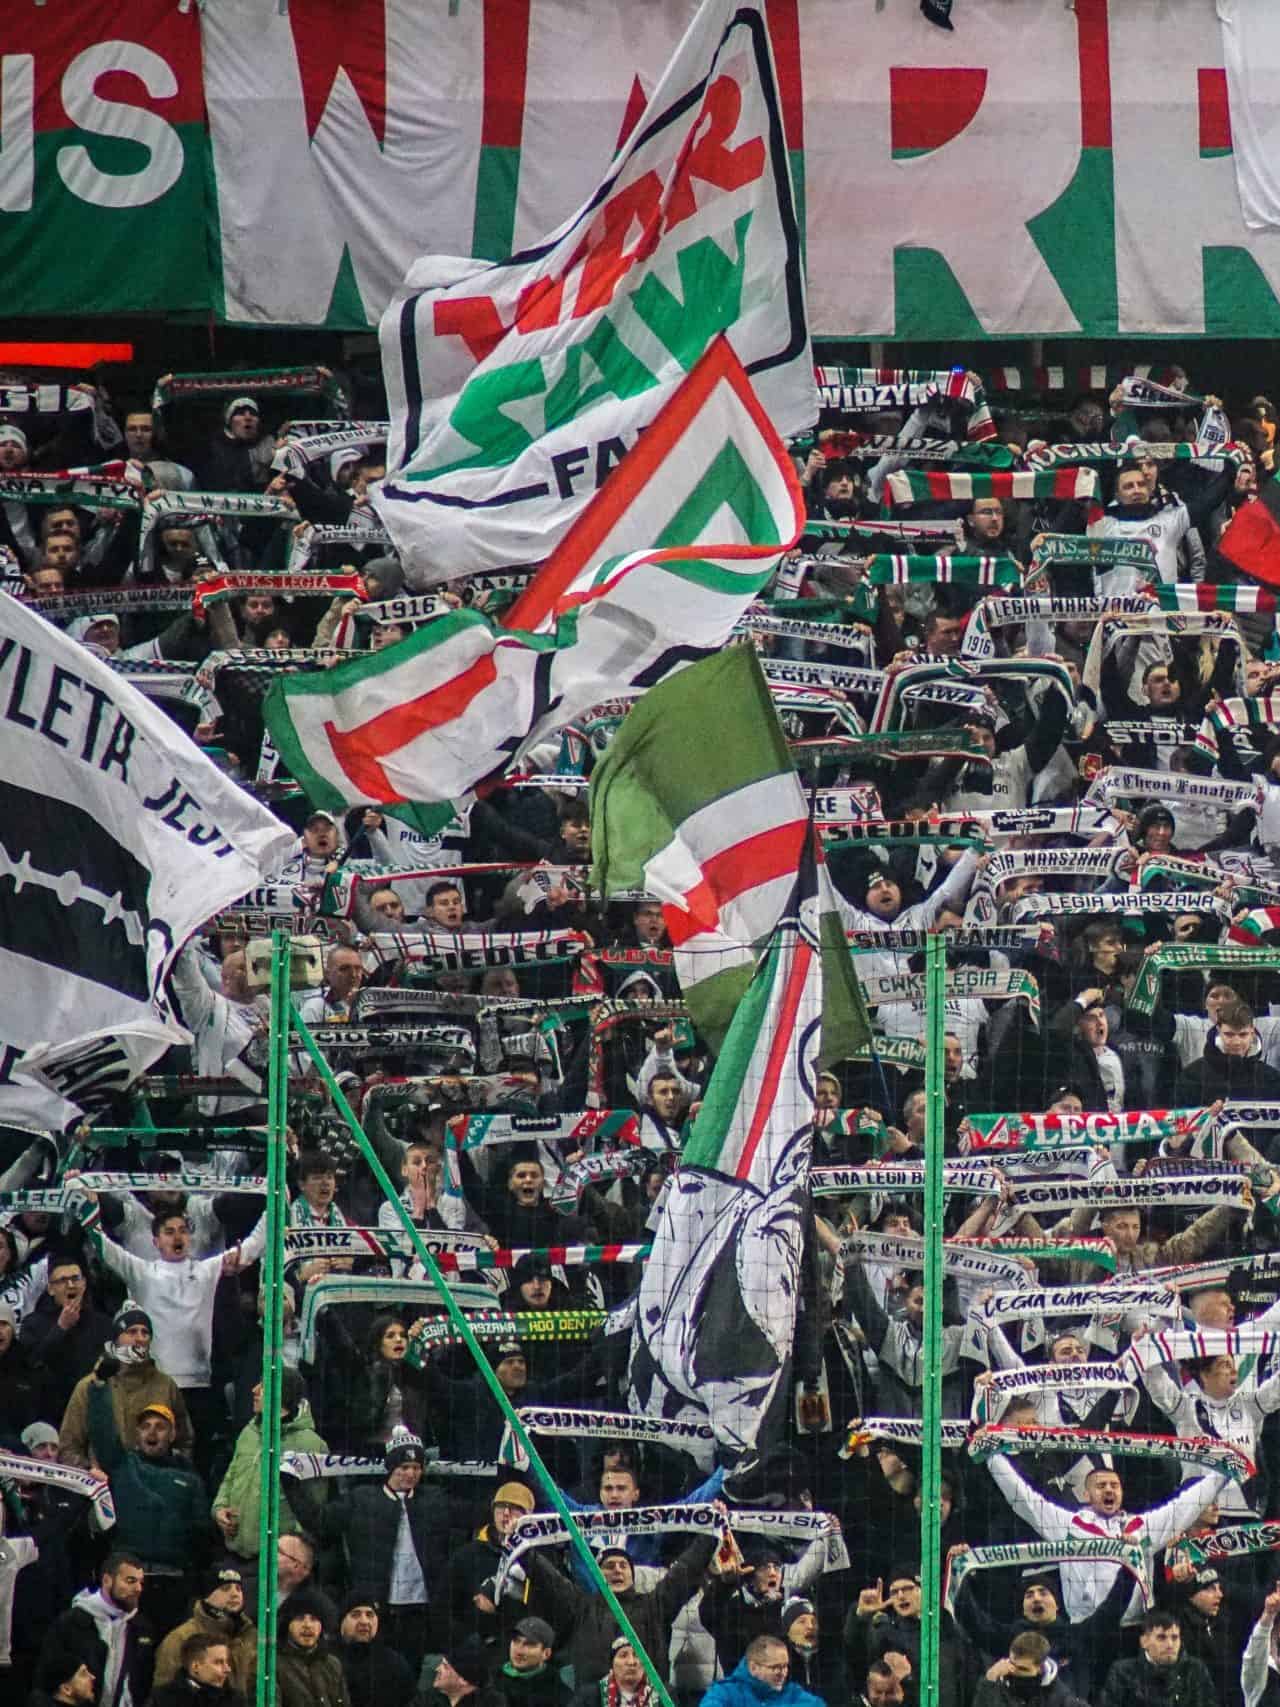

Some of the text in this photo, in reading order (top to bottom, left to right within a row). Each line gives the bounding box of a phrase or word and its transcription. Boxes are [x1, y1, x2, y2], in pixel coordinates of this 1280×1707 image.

[222, 576, 330, 589] CWKS LEGIA
[377, 597, 436, 621] 1916
[993, 596, 1041, 618] LEGIA
[1023, 852, 1112, 869] WARSZAWA
[1049, 895, 1215, 910] LEGIA WARSZAWA
[1031, 1111, 1162, 1147] LEGIA
[834, 1169, 861, 1187] MA
[875, 1169, 907, 1186] LEGII
[984, 1289, 1176, 1318] LEGIA WARSZAWA
[974, 1541, 1124, 1564] LEGIA WARSZAWA
